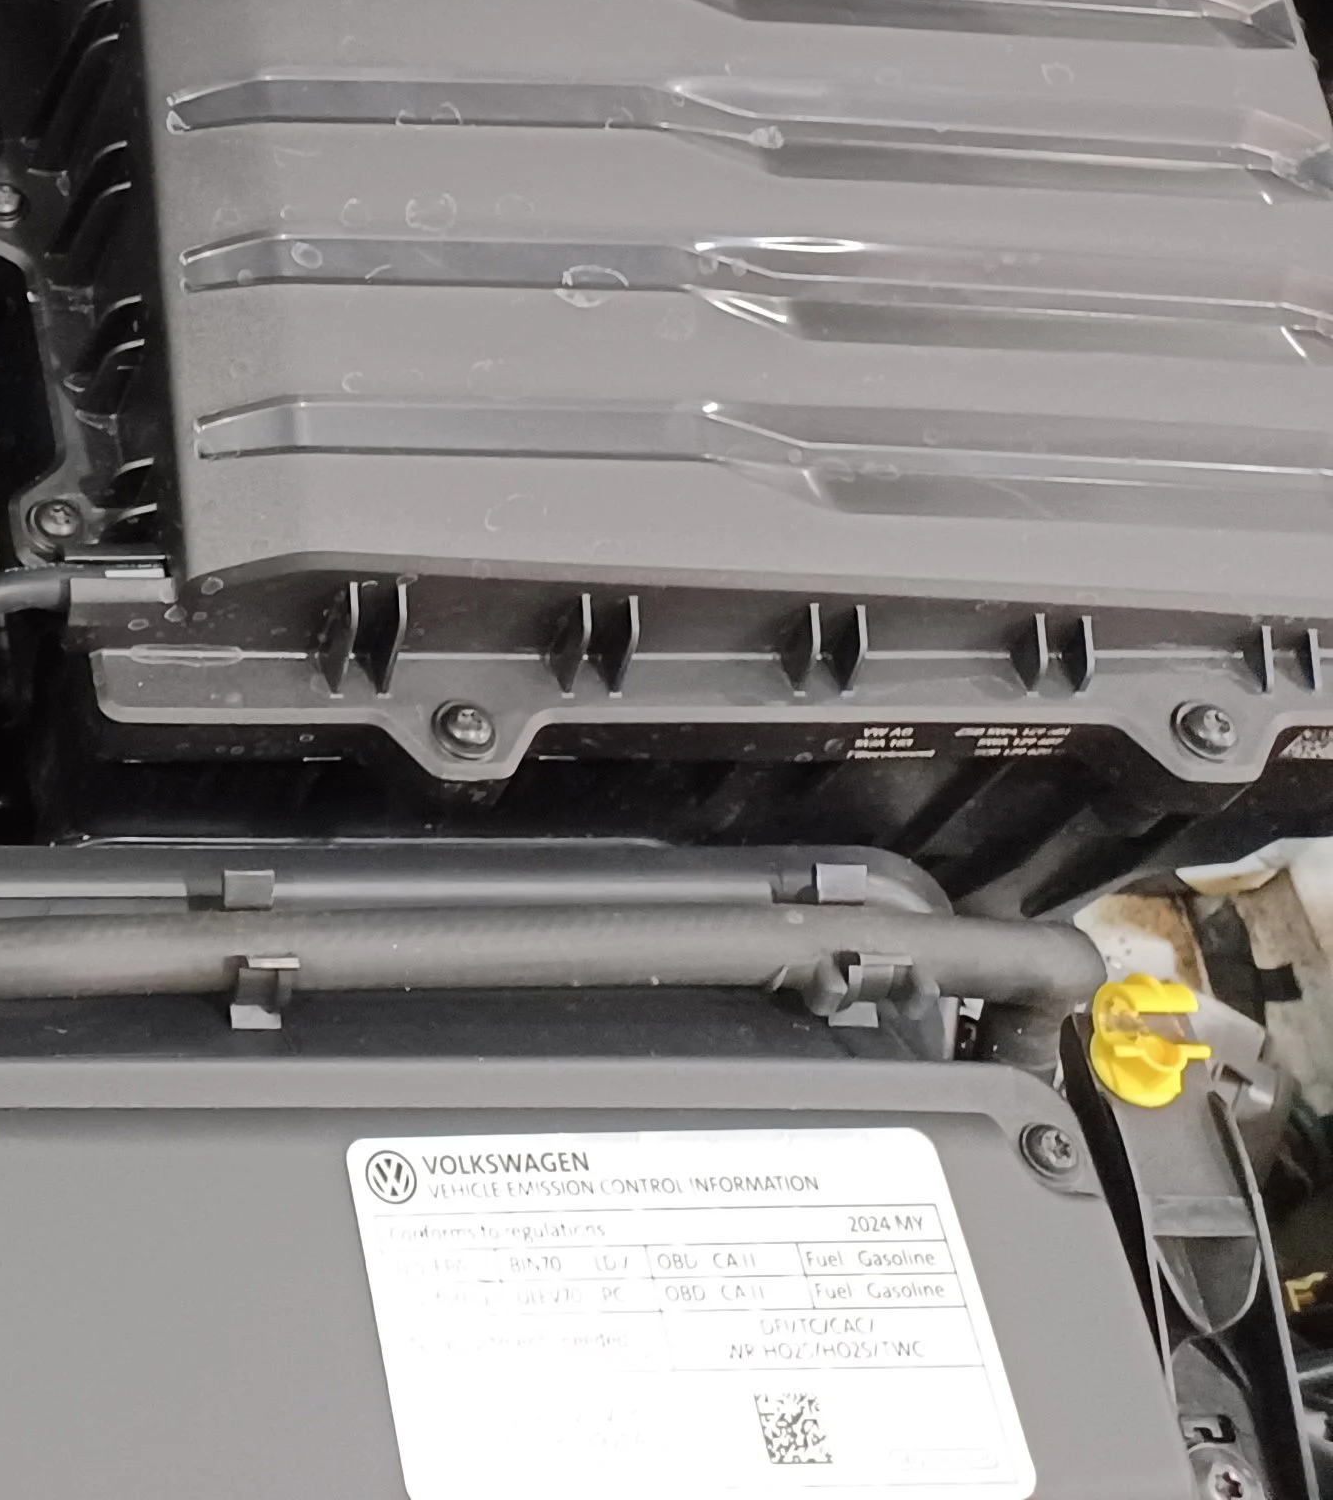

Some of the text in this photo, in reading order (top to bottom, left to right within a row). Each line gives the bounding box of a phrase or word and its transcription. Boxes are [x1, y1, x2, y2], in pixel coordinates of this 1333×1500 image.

[422, 1152, 590, 1175] VOLKSWAGEN
[428, 1175, 819, 1199] VEHICLE EMISSION CONTROL INFORMATION
[847, 1216, 923, 1232] 2024 MY
[805, 1251, 843, 1268] Fuel
[858, 1250, 936, 1267] Gasoline
[665, 1285, 706, 1302] OBD
[815, 1283, 853, 1300] Fuel
[867, 1282, 945, 1300] Gasoline
